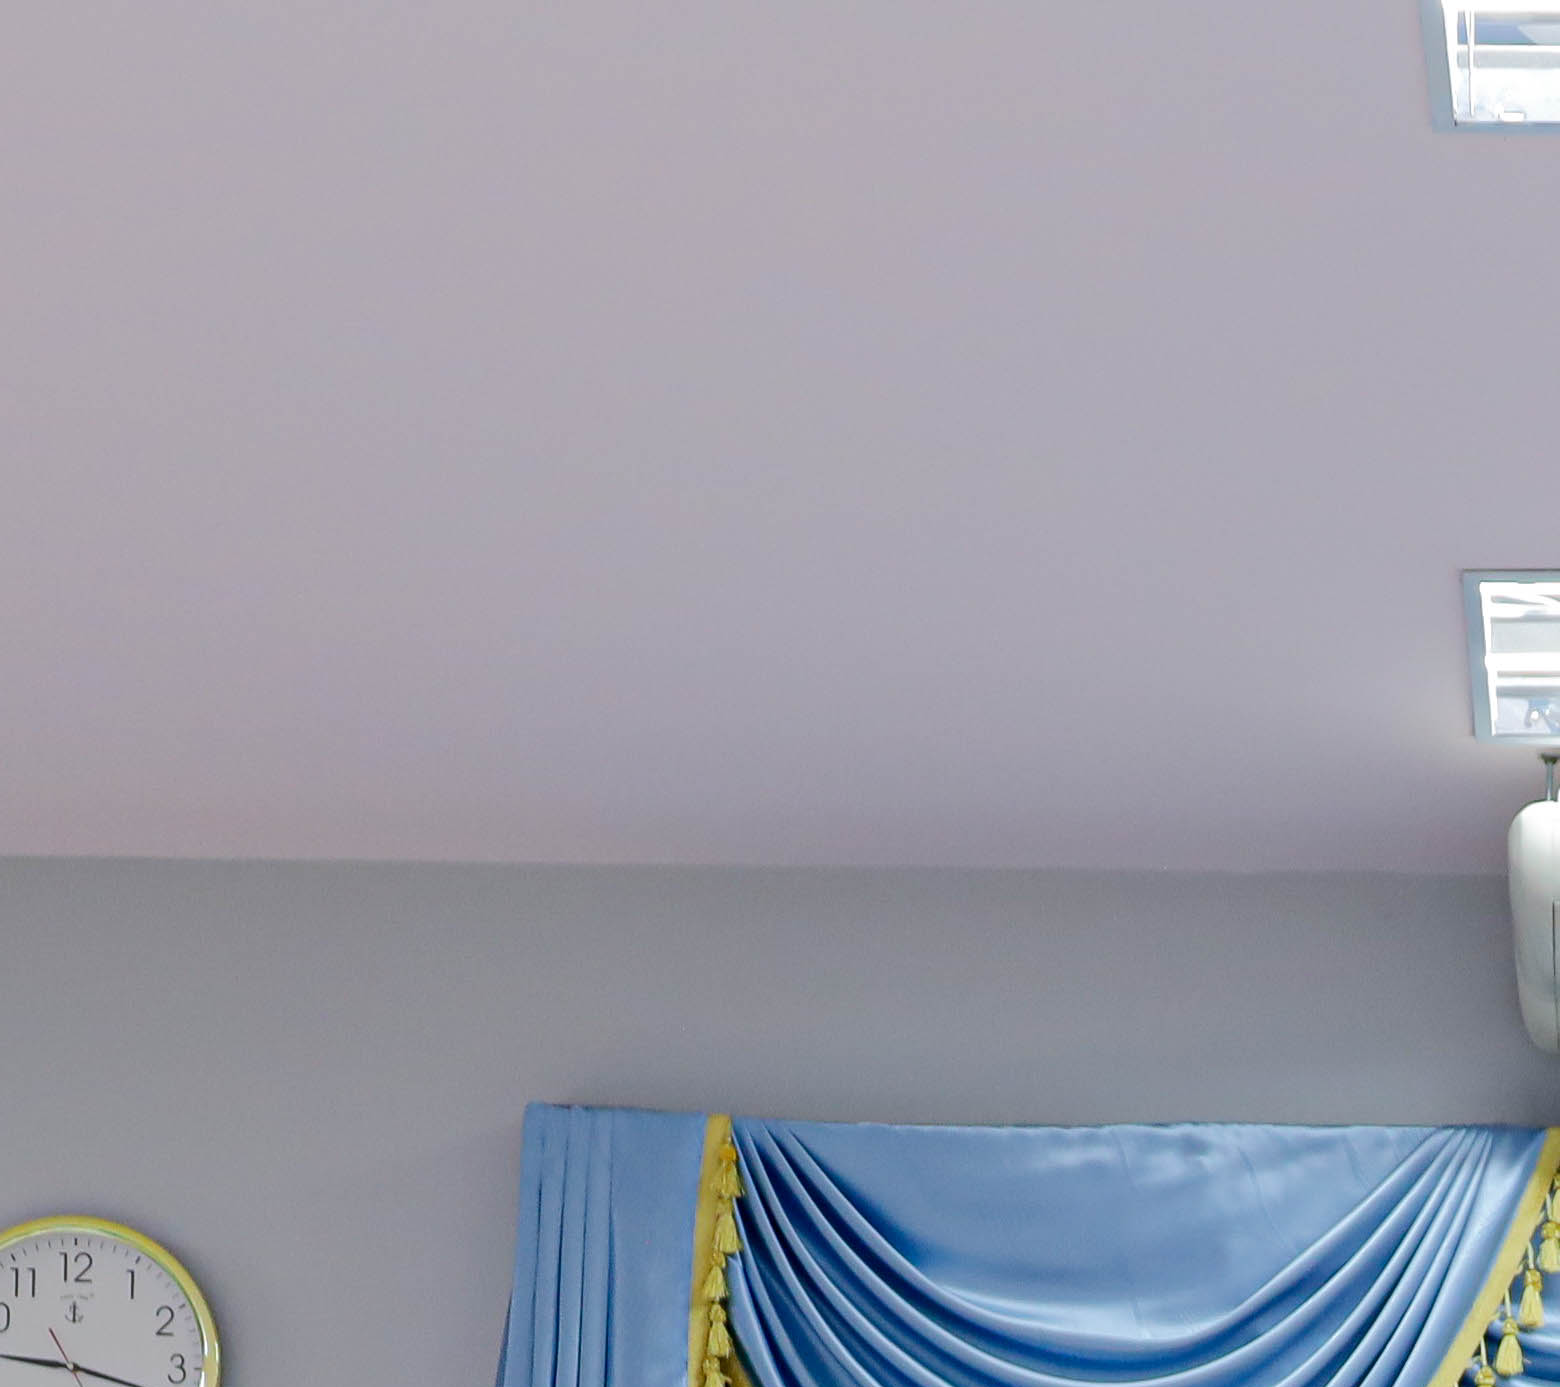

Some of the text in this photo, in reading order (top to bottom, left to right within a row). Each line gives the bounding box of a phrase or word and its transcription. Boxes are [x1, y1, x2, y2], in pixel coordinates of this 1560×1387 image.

[10, 1266, 36, 1298] 11
[59, 1251, 93, 1283] 12
[126, 1269, 135, 1300] 1
[155, 1305, 174, 1336] 2
[167, 1353, 187, 1385] 3
